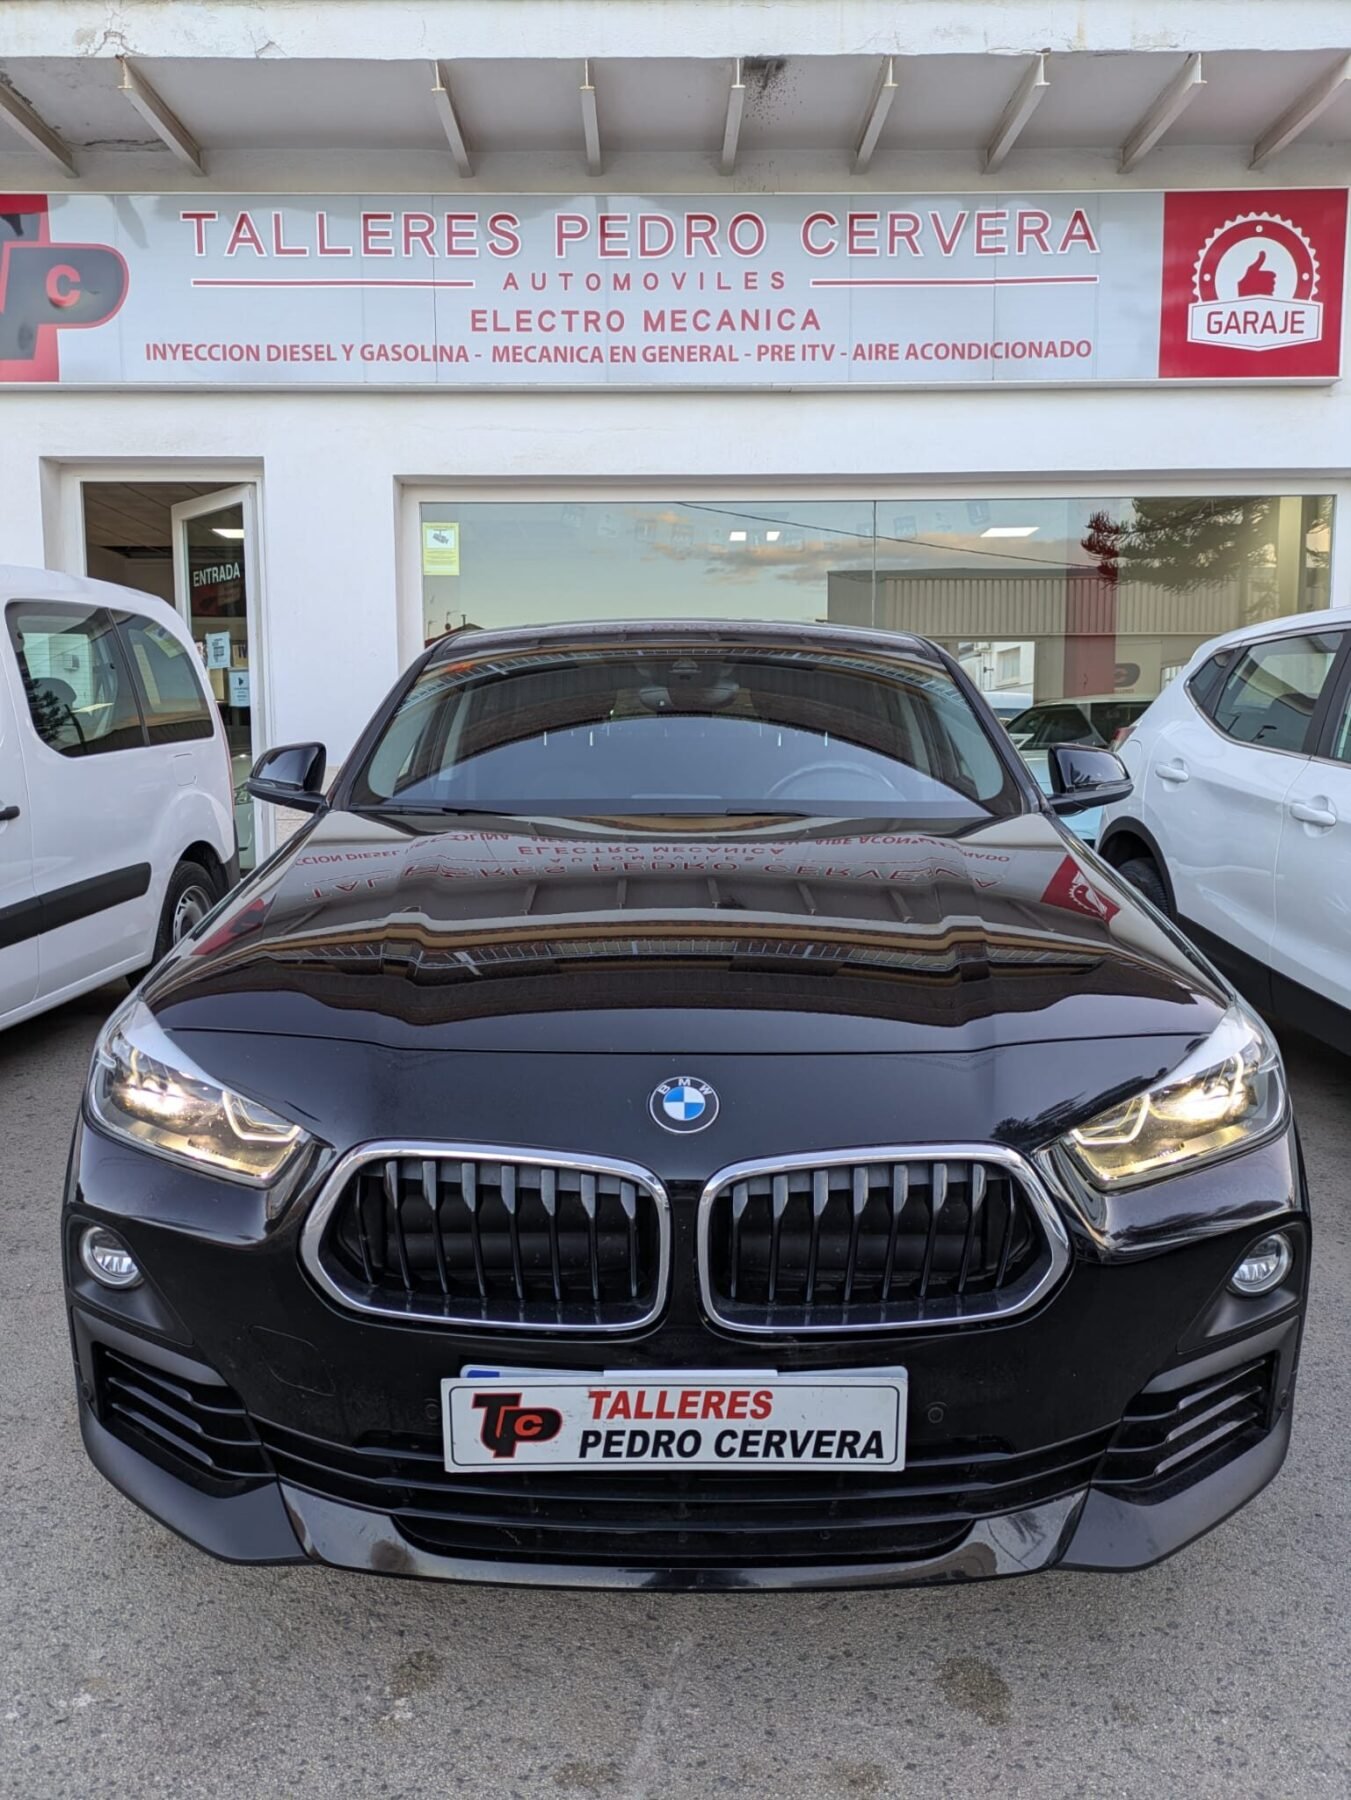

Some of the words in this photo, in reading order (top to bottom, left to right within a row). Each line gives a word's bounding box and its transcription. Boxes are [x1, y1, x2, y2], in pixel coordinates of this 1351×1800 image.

[181, 210, 521, 258] TALLERES
[555, 211, 767, 259] PEDRO
[801, 209, 1099, 257] CERVERA
[503, 271, 786, 292] AUTOMOVILES
[471, 309, 625, 333] ELECTRO
[643, 308, 821, 333] MECANICA
[1206, 310, 1306, 335] GARAJE
[145, 343, 260, 362] INYECCION
[266, 343, 337, 362] DIESEL
[343, 344, 354, 361] Y
[359, 344, 469, 363] GASOLINA
[491, 344, 604, 364] MECANICA
[609, 345, 637, 363] EN
[641, 344, 739, 363] GENERAL
[756, 344, 793, 362] PRE
[801, 343, 835, 361] ITV
[853, 343, 899, 361] AIRE
[904, 340, 1092, 361] ACONDICIONADO
[193, 562, 241, 587] ENTRADA
[656, 1078, 713, 1096] BMW
[587, 1390, 774, 1420] TALLERES
[578, 1429, 702, 1459] PEDRO
[714, 1429, 885, 1459] CERVERA
